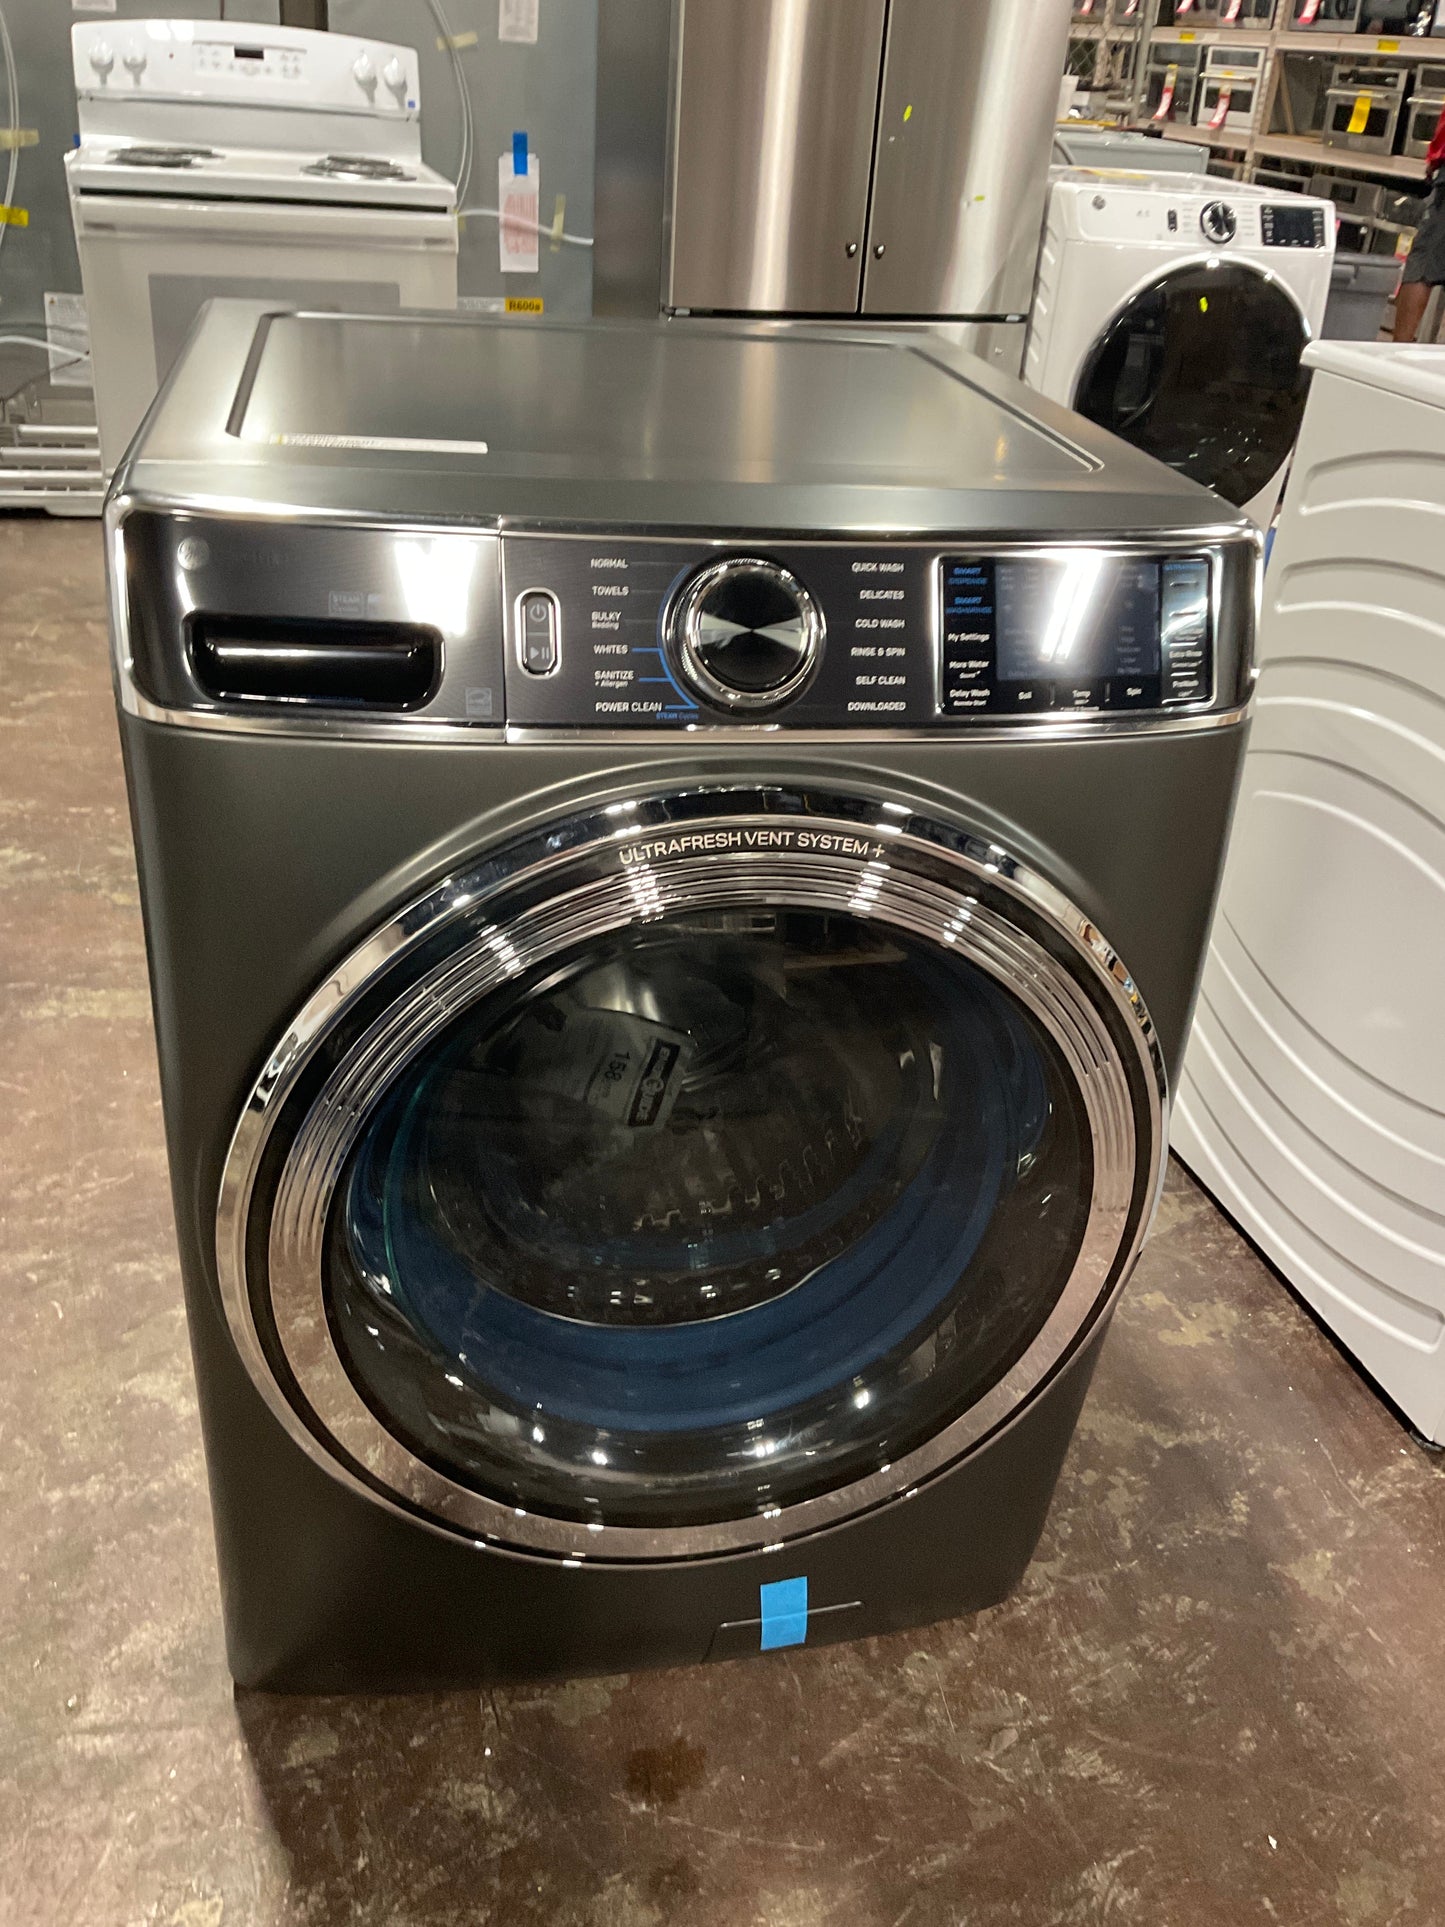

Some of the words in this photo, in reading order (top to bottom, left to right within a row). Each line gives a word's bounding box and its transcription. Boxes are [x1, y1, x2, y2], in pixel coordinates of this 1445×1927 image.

[591, 558, 628, 569] NORMAL
[852, 562, 877, 573] QUICK
[879, 563, 904, 573] WASH
[592, 586, 629, 596] TOWELS
[859, 590, 905, 600] DELICATES
[592, 611, 621, 621] BULKY
[592, 621, 619, 630] Bedding
[855, 619, 879, 629] COLD
[879, 619, 905, 629] WASH
[959, 633, 990, 642] Settings
[593, 645, 628, 654] WHITES
[851, 647, 876, 657] RINSE
[885, 648, 906, 657] SPIN
[594, 670, 634, 680] SANITIZE
[600, 680, 629, 689] Allergen
[855, 676, 878, 686] SELF
[878, 676, 906, 686] CLEAN
[595, 702, 629, 712] POWER
[631, 702, 662, 712] CLEAN
[847, 701, 906, 711] DOWNLOADED
[619, 832, 741, 865] ULTRAFRESH
[743, 831, 794, 847] VENT
[797, 832, 869, 856] SYSTEM
